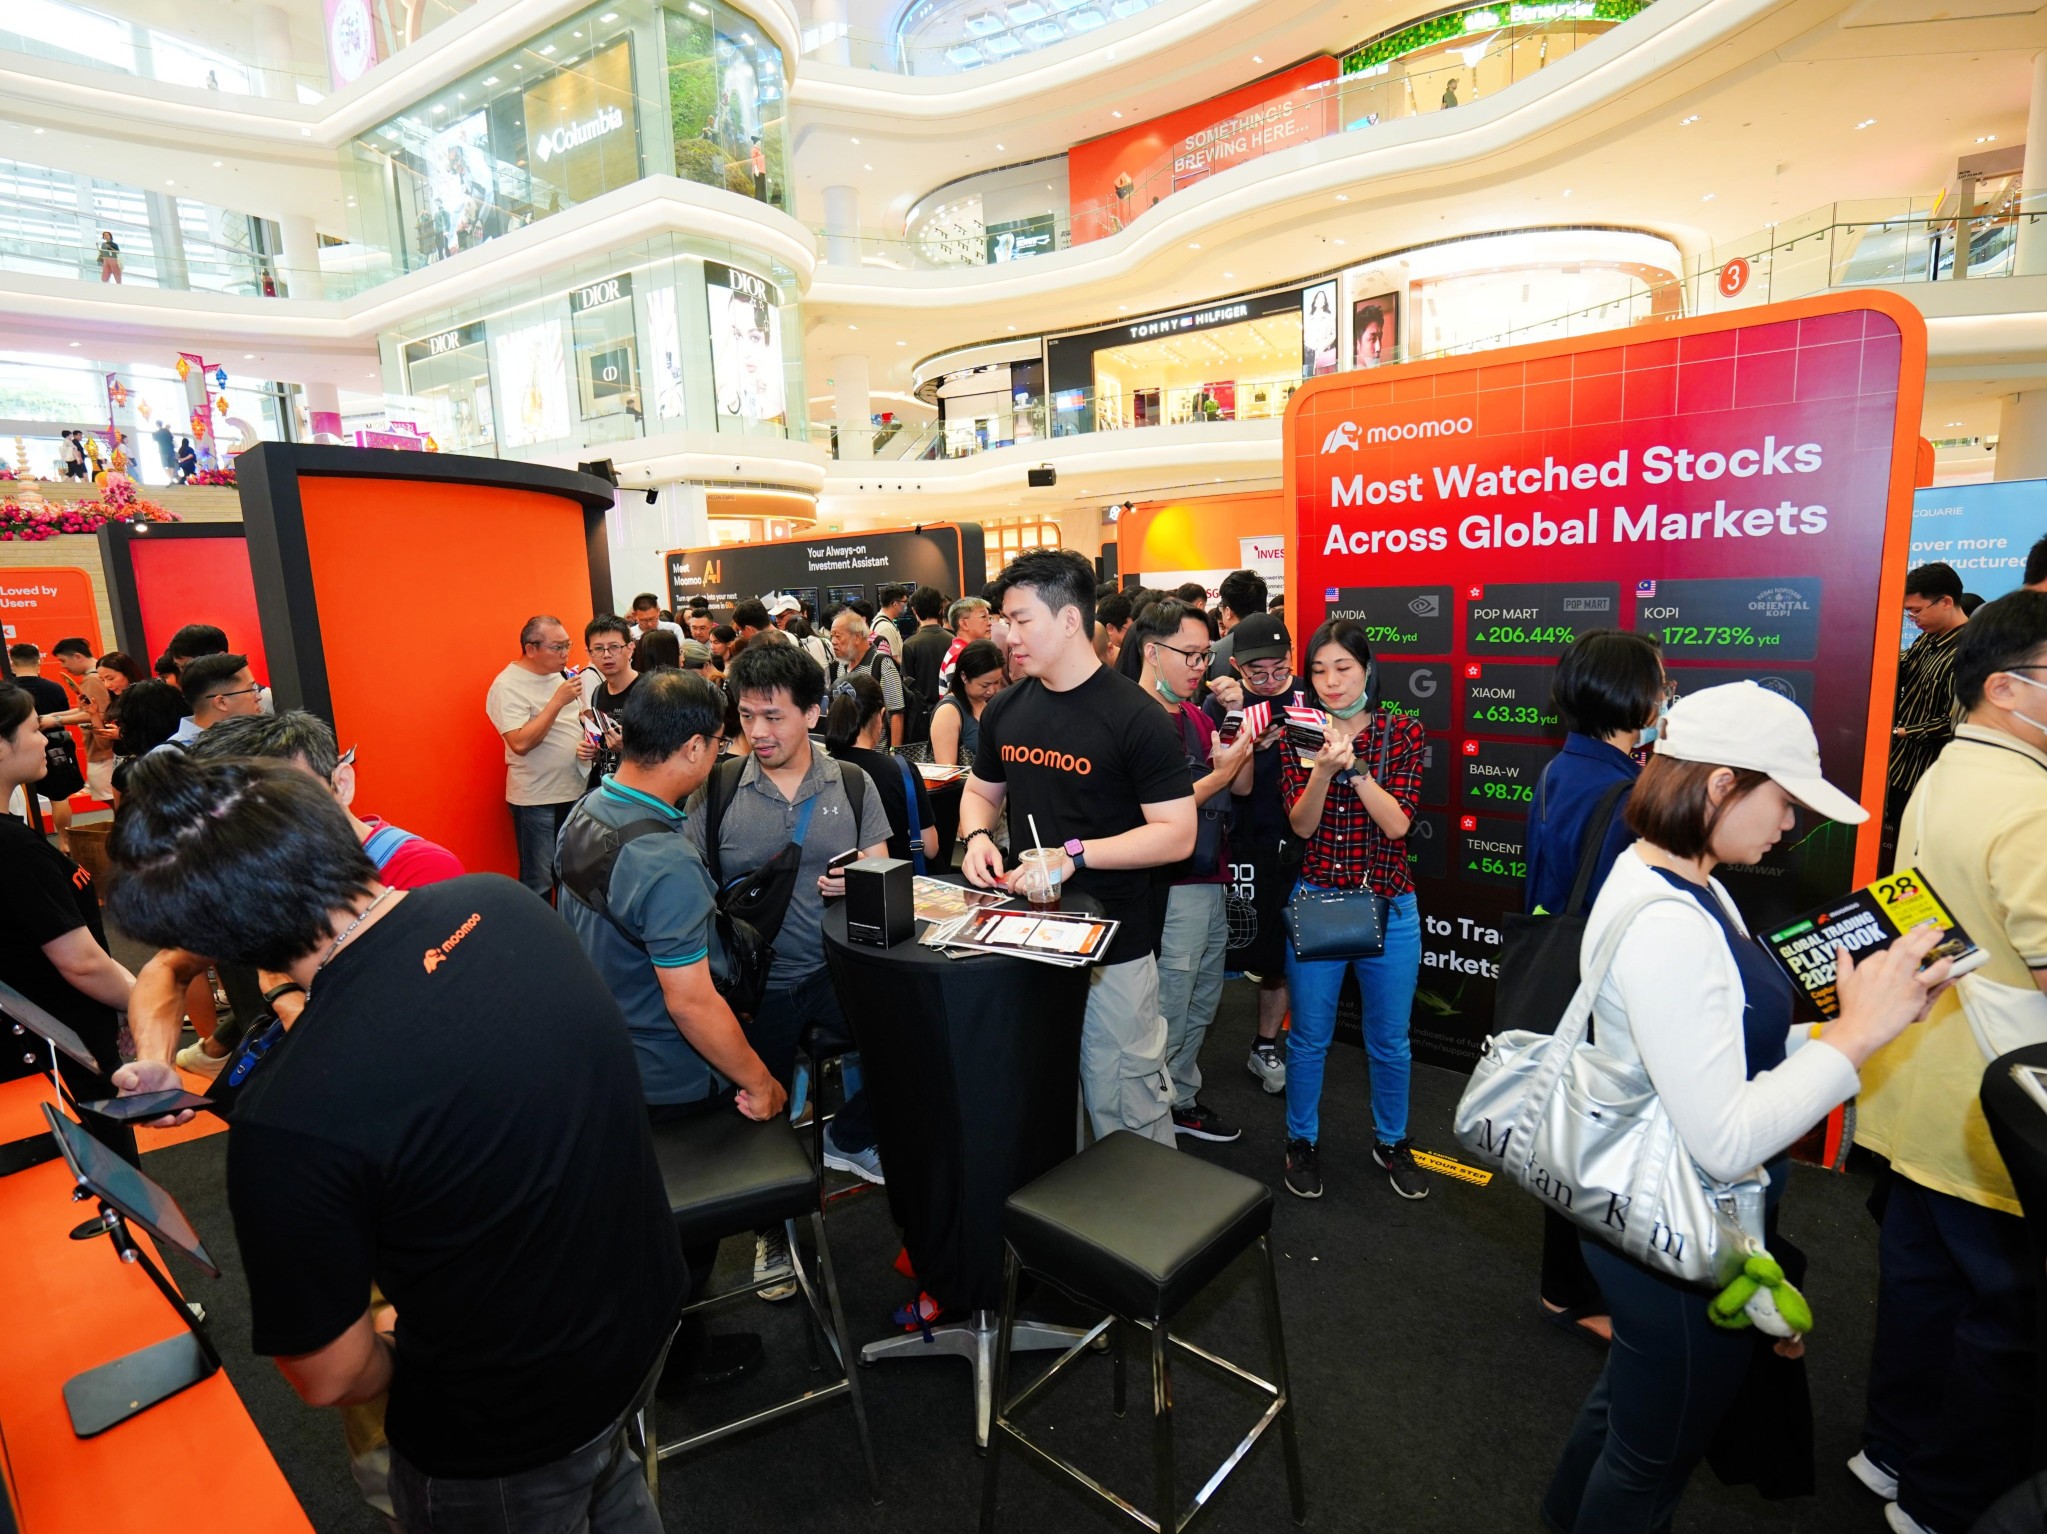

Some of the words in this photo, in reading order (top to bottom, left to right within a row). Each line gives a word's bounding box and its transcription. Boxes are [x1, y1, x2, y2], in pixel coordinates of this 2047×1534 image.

[552, 106, 623, 153] Columbia
[1185, 101, 1293, 150] SOMETHING'S
[1174, 138, 1247, 172] BREWING
[1252, 120, 1309, 148] HERE...
[729, 268, 766, 299] DIOR
[1726, 265, 1740, 291] 3
[581, 280, 620, 309] DIOR
[1130, 319, 1178, 338] TOMMY
[1195, 305, 1248, 325] HILFIGER
[430, 331, 460, 356] DIOR
[1367, 417, 1473, 444] moomoo
[1331, 473, 1422, 507] Most
[1433, 450, 1628, 499] Watched
[1642, 436, 1822, 483] Stocks
[1322, 524, 1448, 555] Across
[1458, 507, 1598, 548] Global
[1612, 500, 1828, 542] Markets
[807, 547, 825, 558] Your
[826, 545, 866, 558] Always-on
[1957, 538, 2008, 549] more
[672, 563, 690, 573] Meet
[702, 559, 721, 587] AI
[808, 559, 850, 571] Investment
[852, 555, 889, 568] Assistant
[674, 575, 702, 586] Moomoo
[0, 586, 39, 595] Loved
[41, 586, 57, 597] by
[0, 600, 37, 608] Users
[1474, 609, 1500, 619] POP
[1502, 608, 1539, 619] MART
[1565, 600, 1582, 609] POP
[1584, 599, 1608, 609] MART
[1644, 607, 1679, 619] KOPI
[1748, 601, 1810, 610] ORIENTAL
[1331, 610, 1366, 620] NVIDIA
[1402, 633, 1417, 643] ytd
[1489, 627, 1575, 643] 206.44%
[1662, 627, 1754, 644] 172.73%
[1758, 634, 1780, 647] ytd
[1472, 688, 1515, 699] XIAOMI
[1486, 706, 1538, 723] 63.33
[1540, 715, 1558, 725] ytd
[1001, 745, 1091, 775] moomoo
[1469, 764, 1519, 778] BABA-W
[1484, 782, 1533, 801] 98.76
[1467, 839, 1523, 855] TENCENT
[1482, 858, 1527, 877] 56.12
[1879, 877, 1918, 904] 28
[442, 913, 481, 953] moomoo
[1426, 915, 1452, 936] to
[1457, 917, 1503, 945] Tra
[1779, 933, 1825, 958] GLOBAL
[1821, 911, 1876, 940] TRADING
[1787, 922, 1888, 974] PLAYBOOK
[1419, 948, 1500, 979] arkets
[1799, 961, 1838, 990] 202
[1429, 1158, 1457, 1171] YOUR
[1459, 1168, 1487, 1179] STEP
[1601, 1190, 1684, 1263] Km
